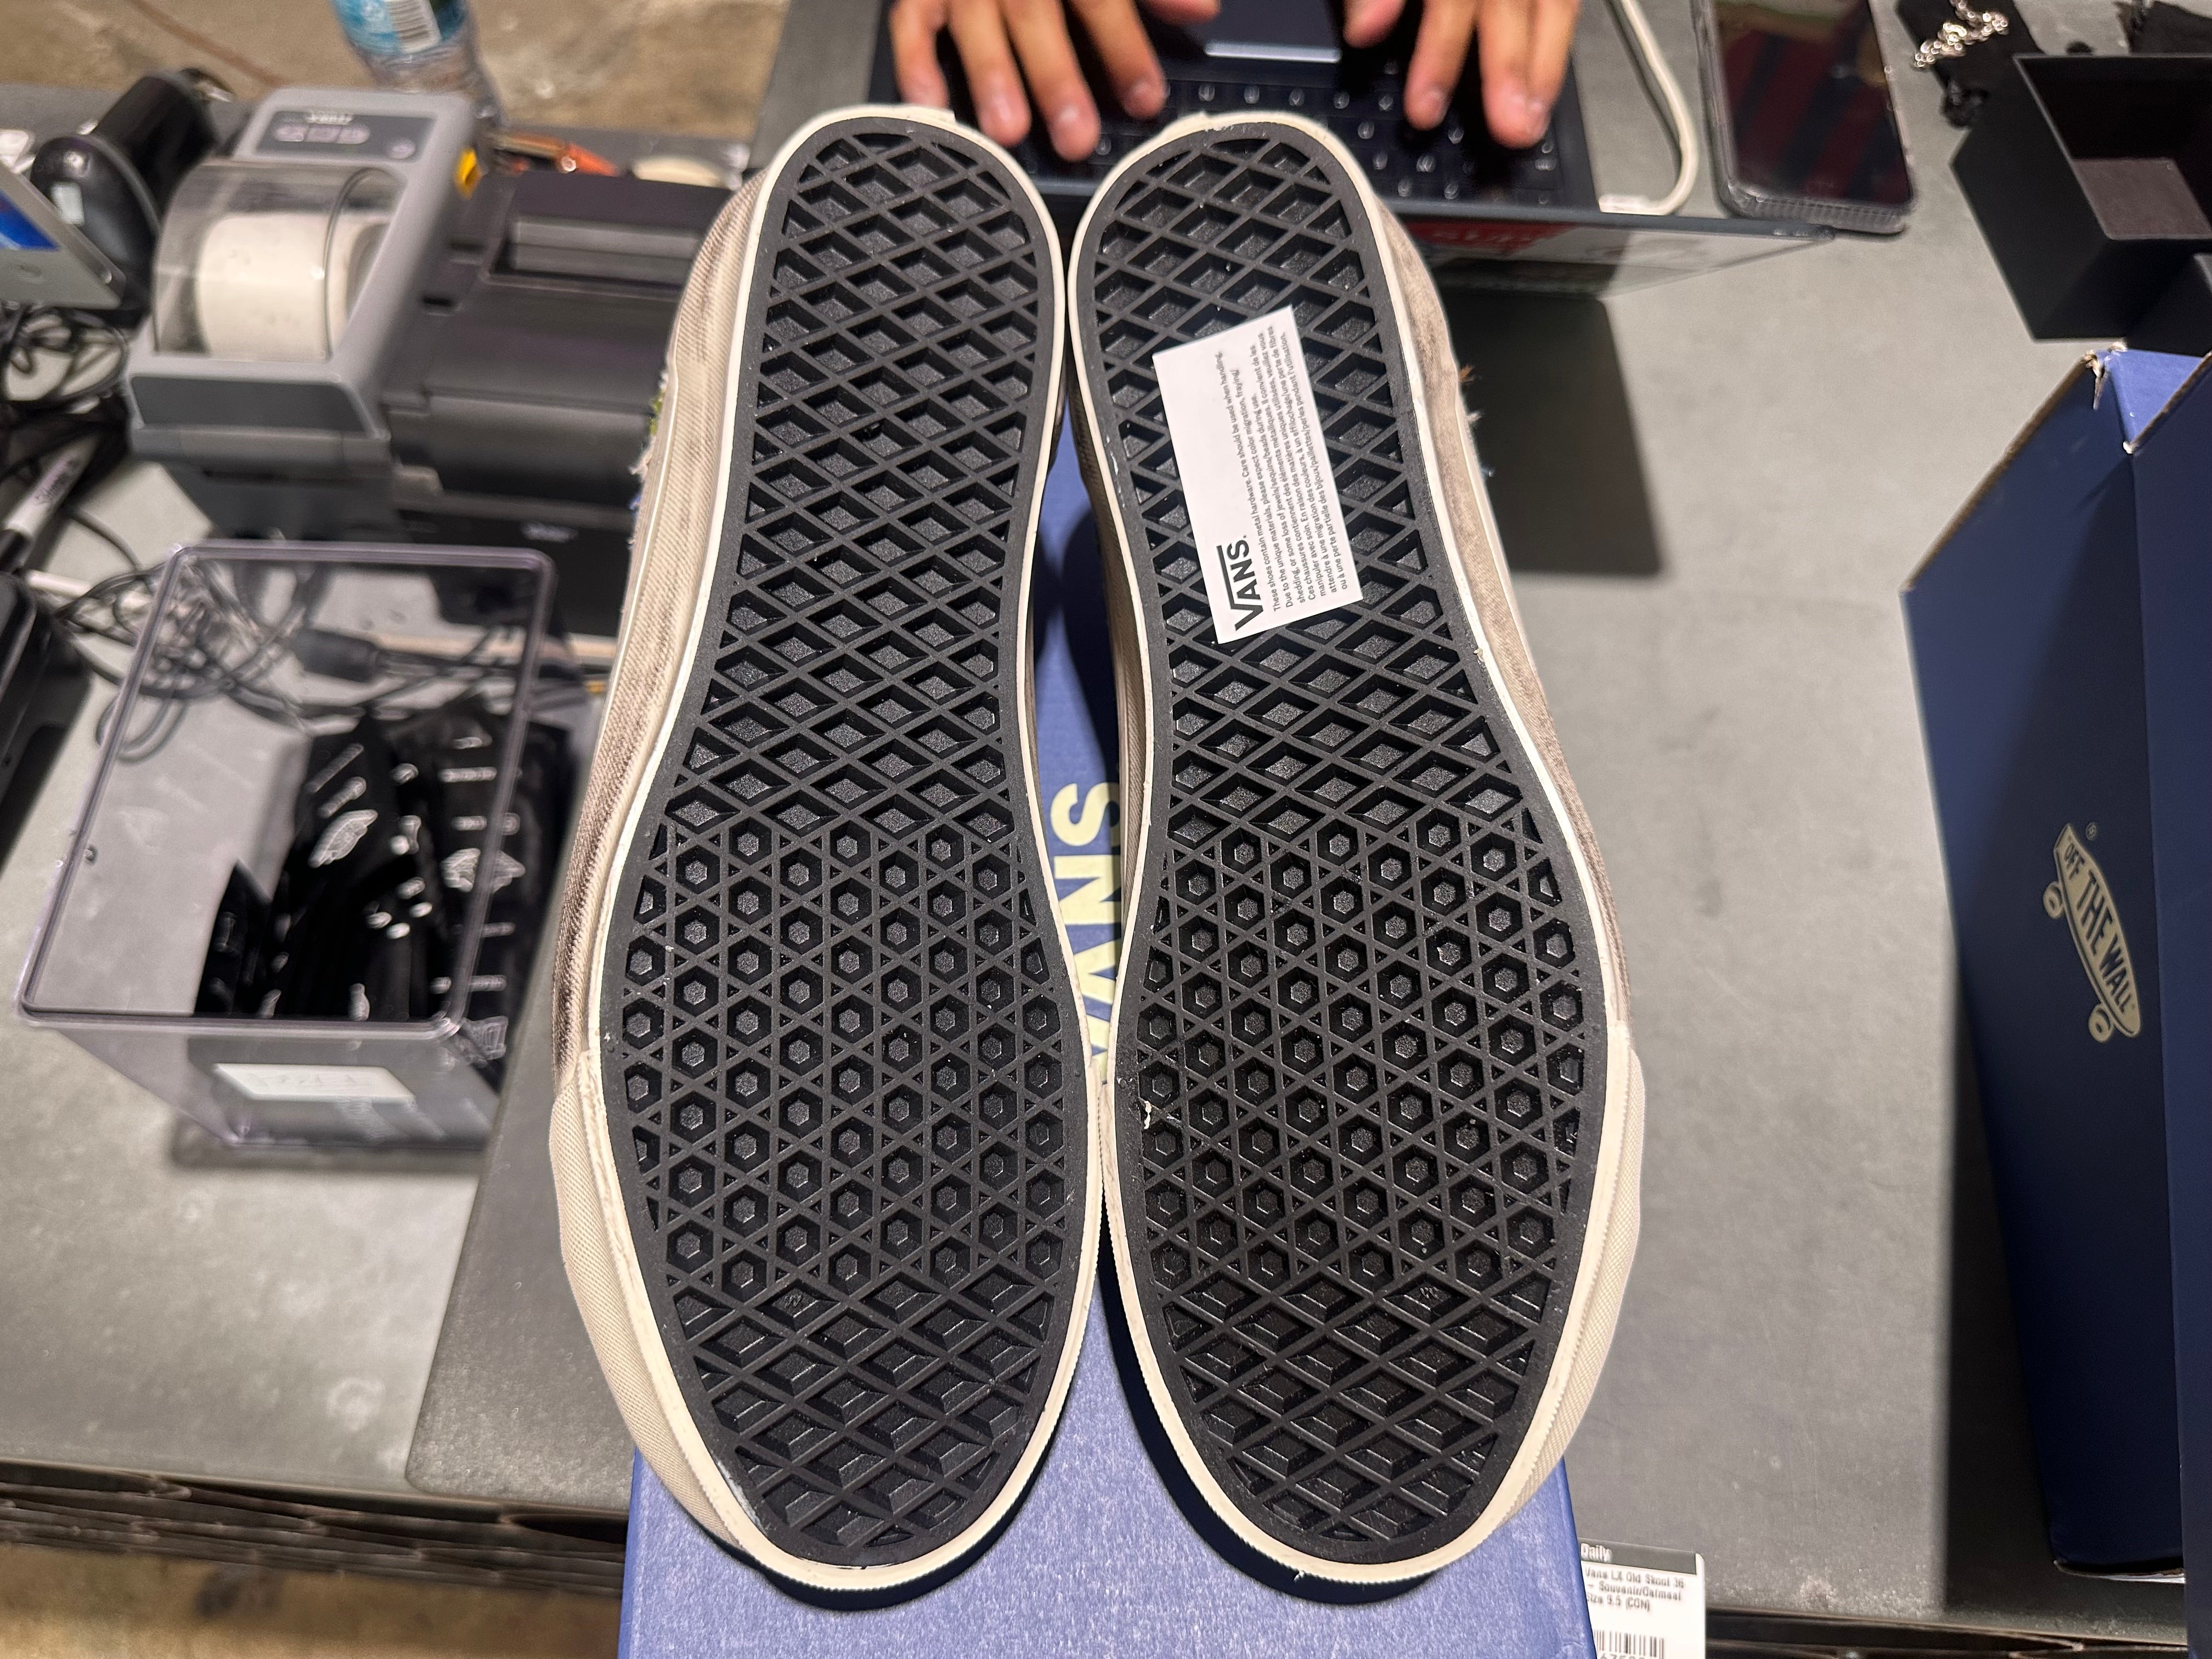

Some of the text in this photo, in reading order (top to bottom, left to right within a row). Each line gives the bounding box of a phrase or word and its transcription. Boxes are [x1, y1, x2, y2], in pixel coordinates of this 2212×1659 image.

[1258, 333, 1266, 351] vous
[1267, 326, 1277, 348] fibres
[1252, 357, 1259, 366] de
[1262, 351, 1273, 378] veuillez
[1272, 349, 1279, 358] de
[1276, 359, 1286, 379] perte
[1255, 366, 1268, 398] convient
[1290, 375, 1304, 406] pendant
[1223, 385, 1232, 405] when
[1226, 405, 1237, 423] used
[1254, 409, 1265, 433] during
[1232, 424, 1239, 434] be
[1277, 411, 1288, 440] uniques
[1233, 434, 1245, 459] should
[1248, 437, 1257, 454] color
[1295, 437, 1301, 447] un
[1241, 459, 1249, 477] Care
[1251, 455, 1263, 479] expect
[1259, 481, 1270, 505] please
[1295, 488, 1305, 511] raison
[1318, 490, 1327, 504] des
[1252, 515, 1263, 536] metal
[1286, 497, 1302, 541] contiennent
[1301, 511, 1308, 522] En
[1310, 503, 1323, 538] migration
[1321, 505, 1336, 535] partielle
[1259, 537, 1270, 565] contain
[1273, 543, 1284, 568] unique
[1285, 537, 1294, 557] some
[1308, 541, 1317, 558] avec
[1330, 537, 1341, 557] perte
[1297, 542, 1312, 584] chaussures
[1216, 539, 1263, 631] VANS
[1266, 566, 1276, 588] shoes
[1279, 569, 1287, 582] the
[1312, 560, 1326, 596] manipuler
[1324, 561, 1336, 592] attendre
[1340, 579, 1347, 589] ou
[1283, 583, 1289, 591] to
[1271, 589, 1281, 612] These
[2064, 843, 2132, 1014] OFF THE WALL
[1585, 1567, 1607, 1579] Vans
[1627, 1571, 1641, 1583] Old
[1645, 1574, 1669, 1587] Skool
[1607, 1595, 1621, 1606] 9.5
